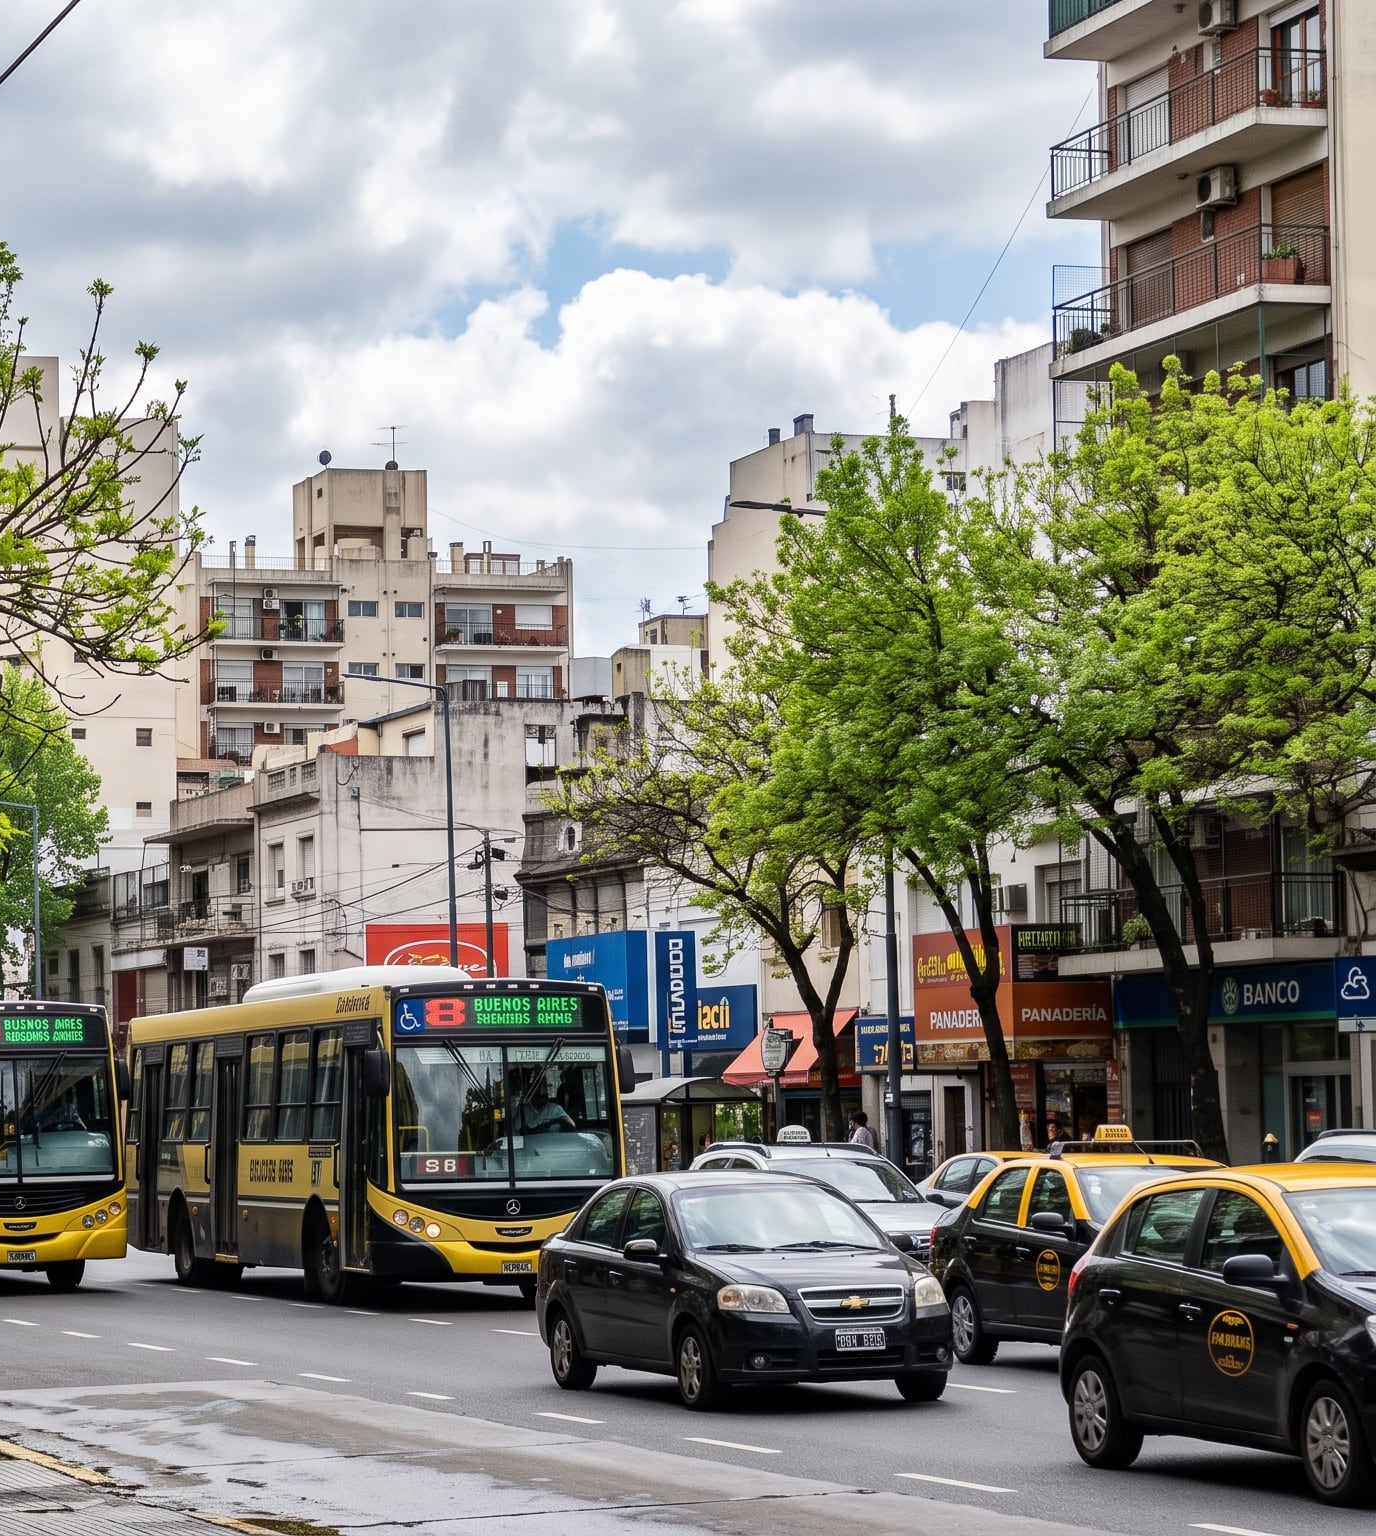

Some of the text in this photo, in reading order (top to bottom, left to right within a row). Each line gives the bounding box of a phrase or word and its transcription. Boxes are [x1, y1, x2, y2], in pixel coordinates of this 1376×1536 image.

[1243, 980, 1300, 1006] BANCO
[474, 998, 578, 1011] BUENOS AIRES
[1021, 1004, 1107, 1022] PANADERÍA
